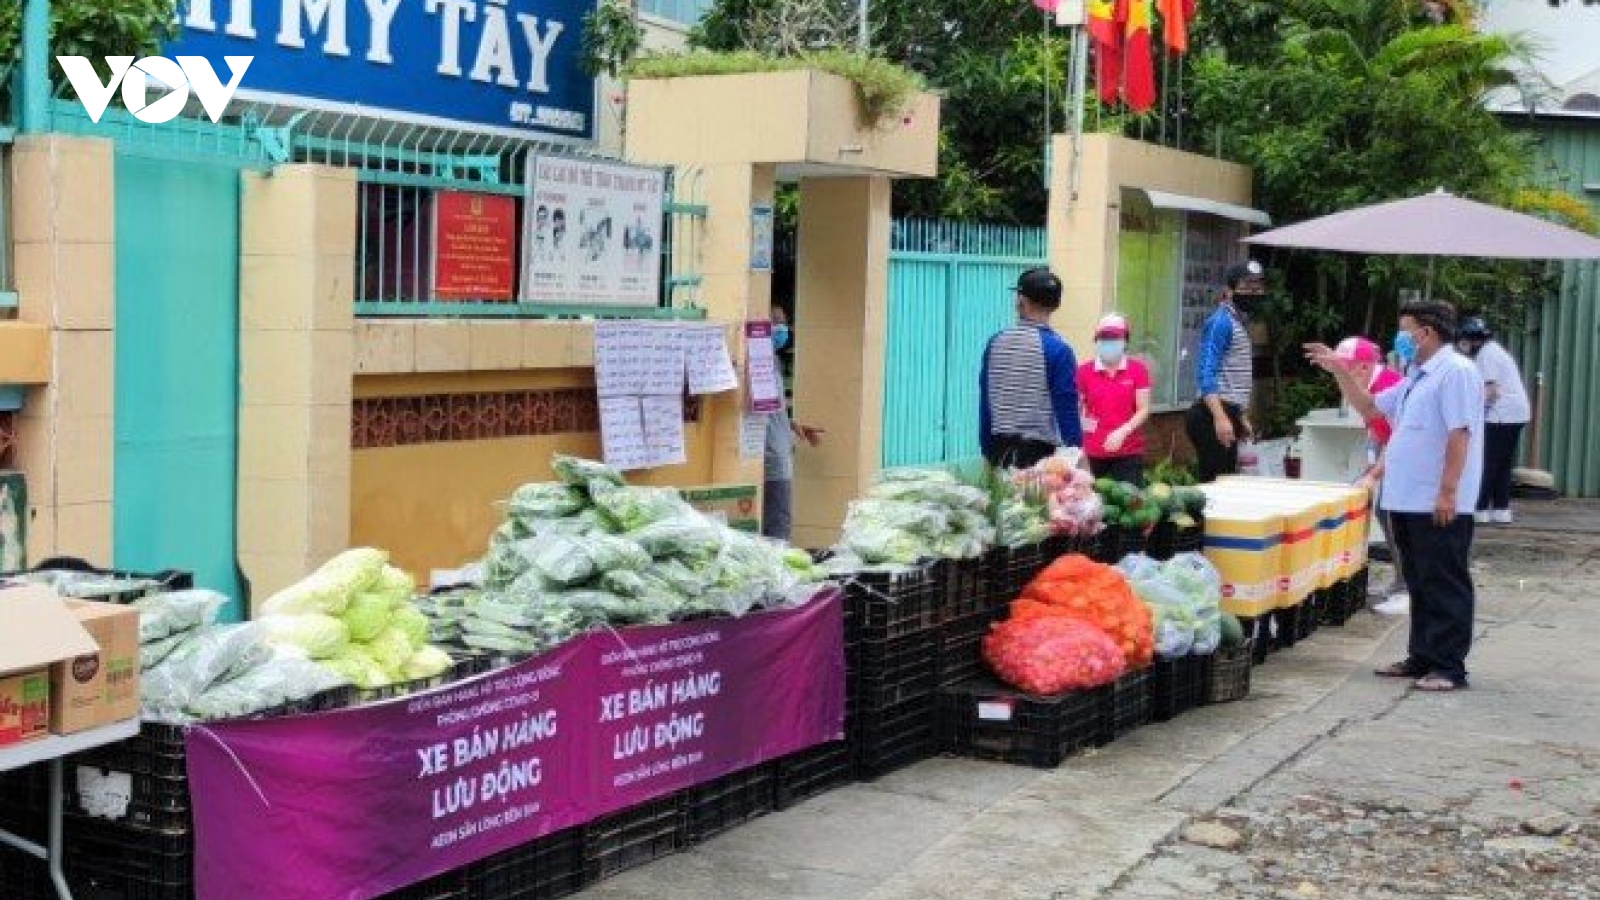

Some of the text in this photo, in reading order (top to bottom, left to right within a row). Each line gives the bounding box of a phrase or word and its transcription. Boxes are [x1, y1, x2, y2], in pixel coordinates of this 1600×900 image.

[599, 670, 721, 722] XE BÁN HÀNG
[417, 708, 557, 778] XE BÁN HÀNG
[613, 710, 704, 760] LƯU ĐỘNG
[431, 756, 541, 818] LƯU ĐỘNG
